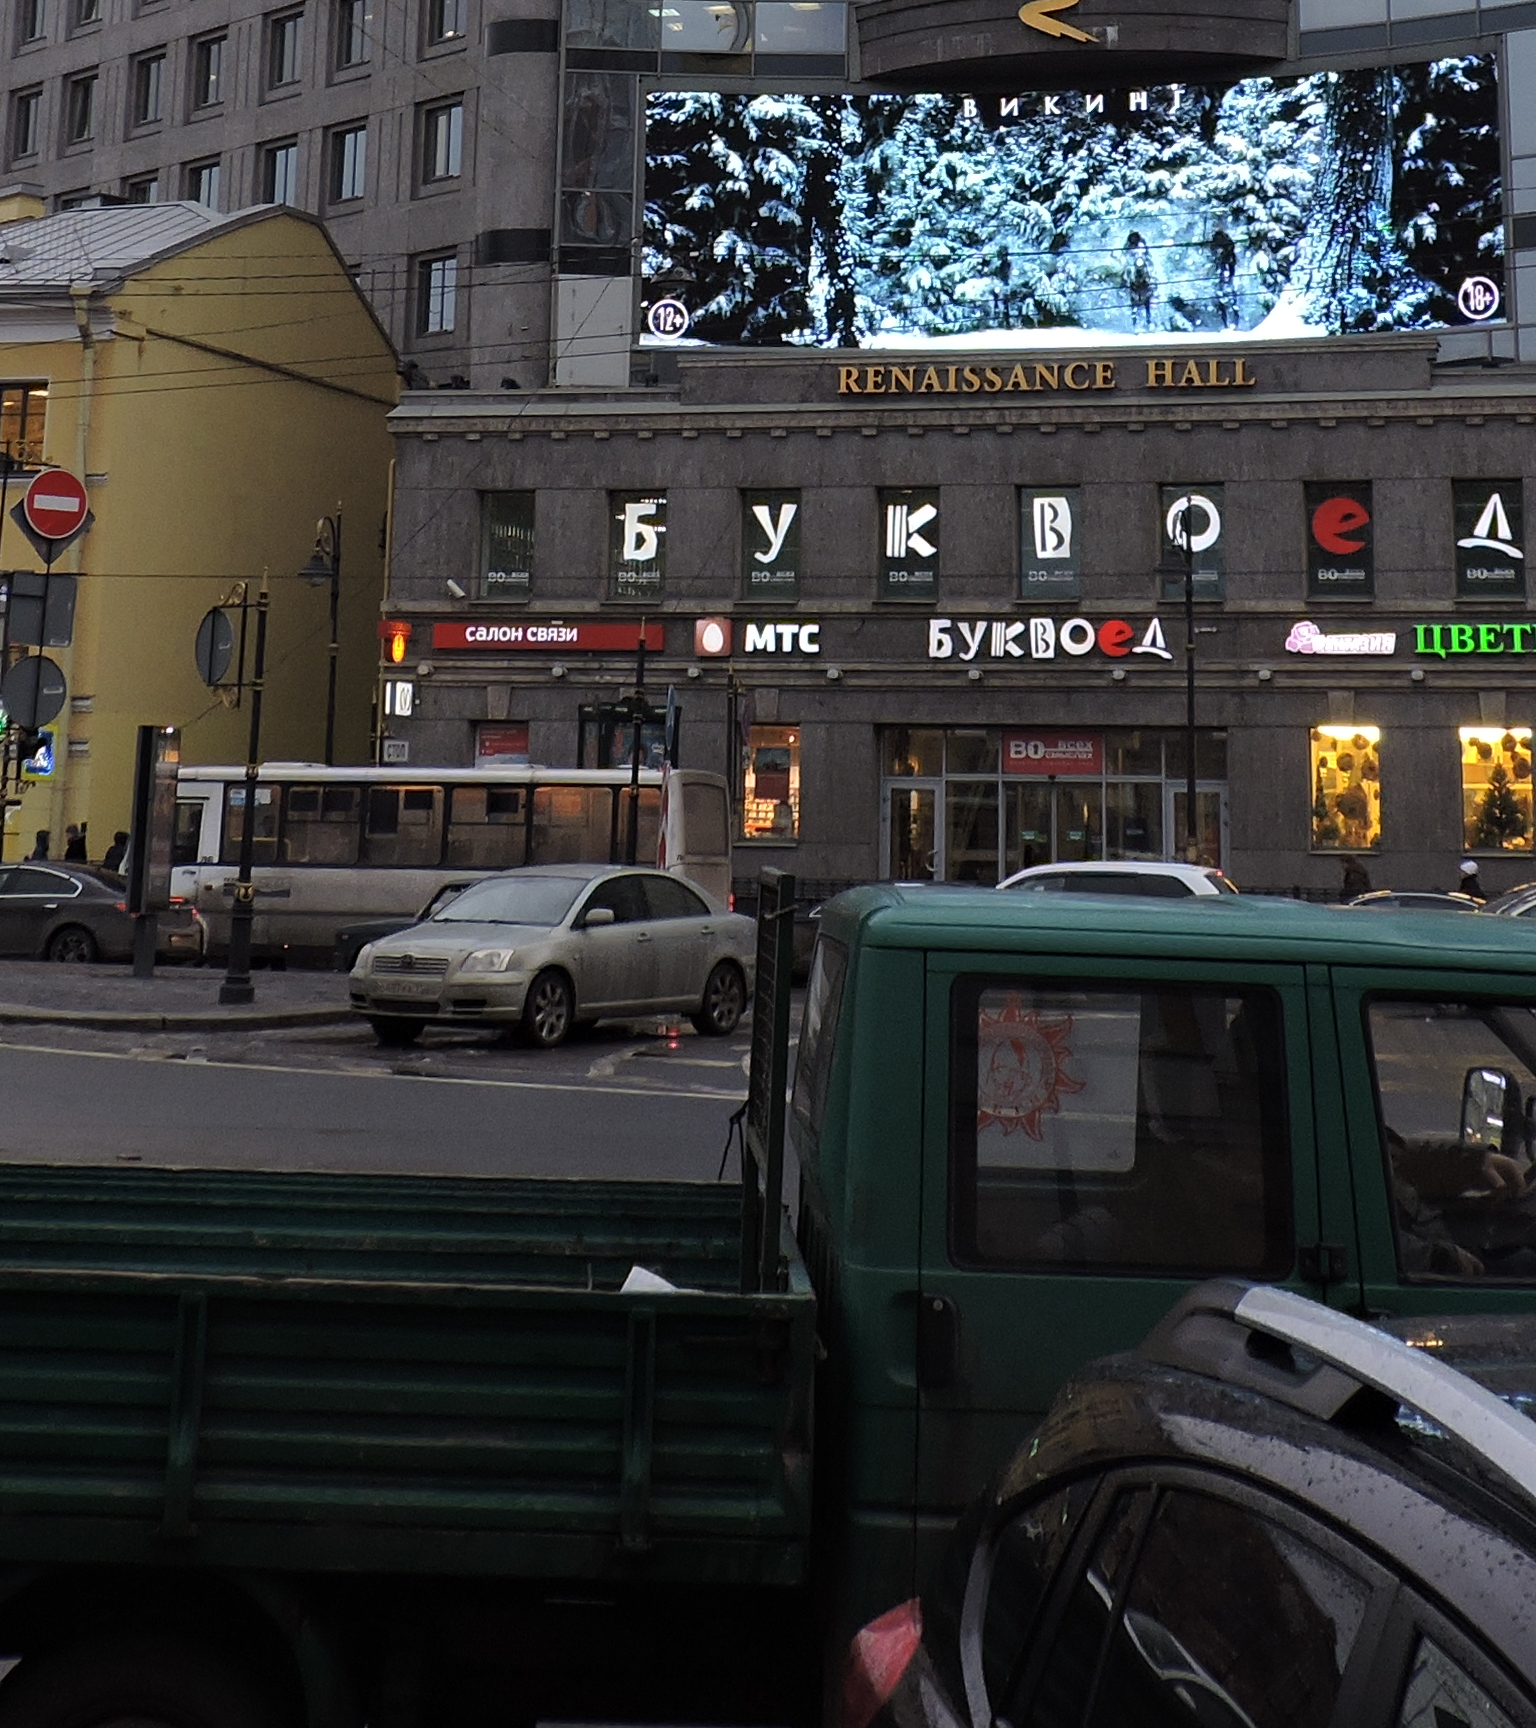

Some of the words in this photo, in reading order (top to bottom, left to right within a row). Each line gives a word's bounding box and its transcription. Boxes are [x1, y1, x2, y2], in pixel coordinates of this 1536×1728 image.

[1467, 285, 1493, 311] 18+
[658, 306, 684, 331] 12+
[837, 362, 1116, 394] RENAISSANCE
[1145, 358, 1257, 388] HALL
[745, 623, 821, 653] МТС
